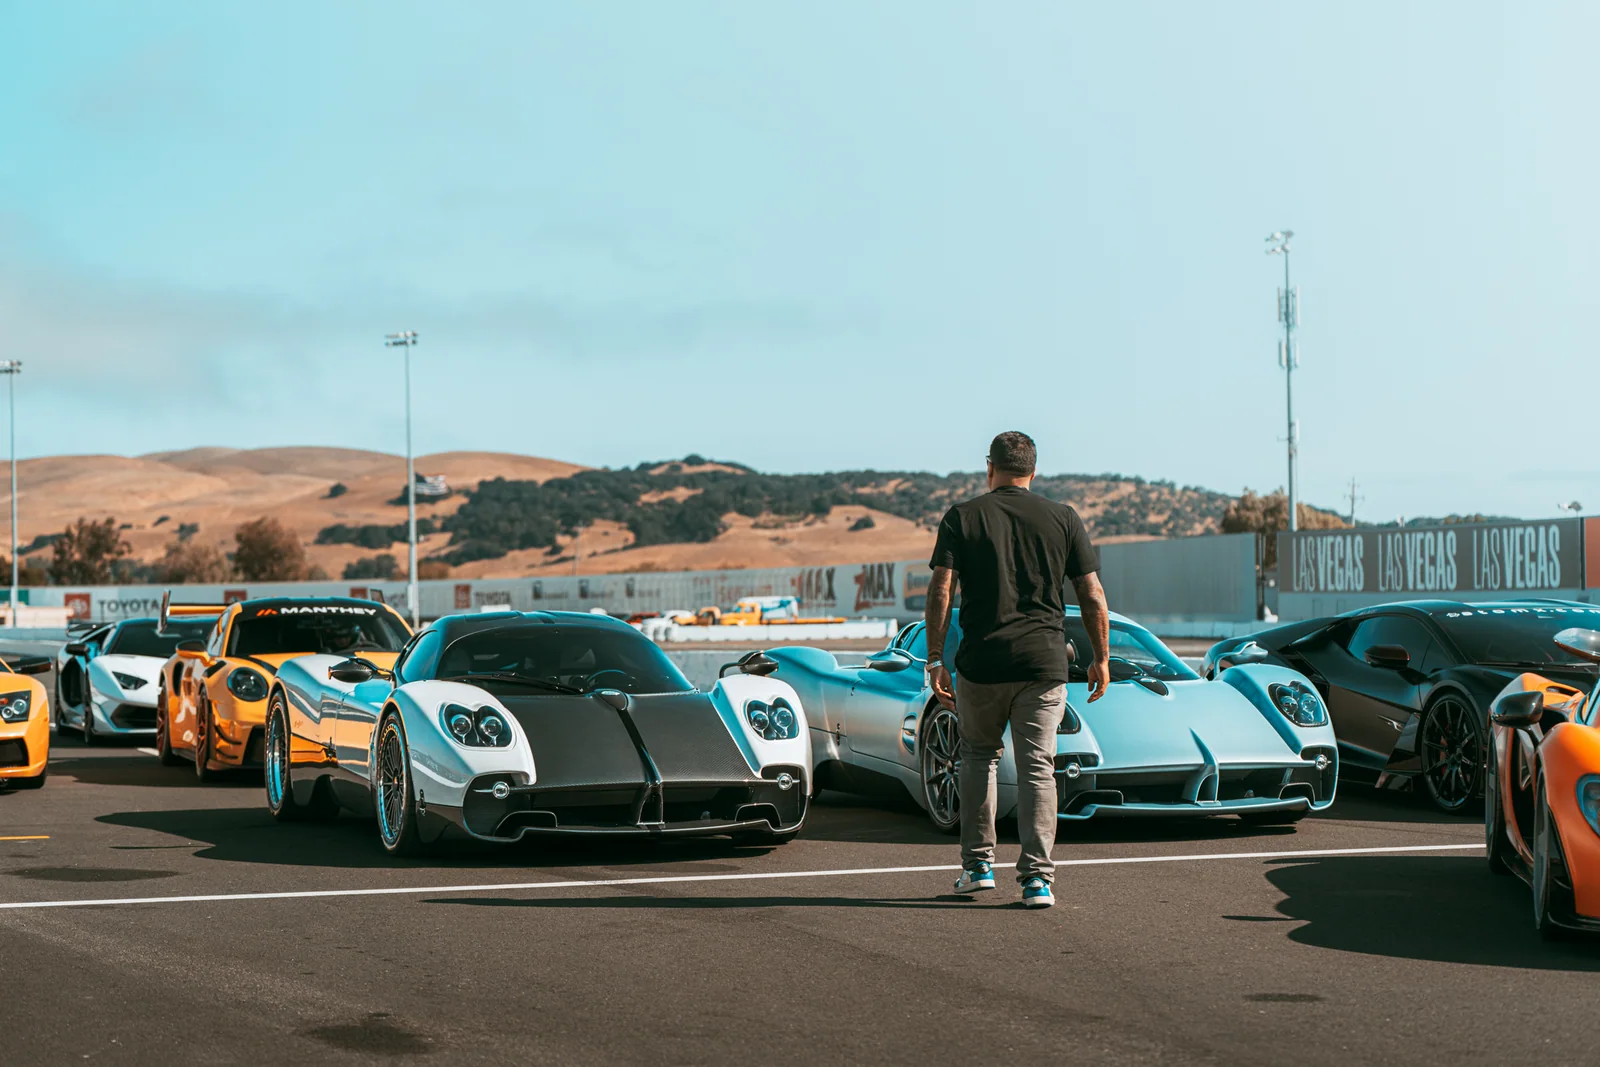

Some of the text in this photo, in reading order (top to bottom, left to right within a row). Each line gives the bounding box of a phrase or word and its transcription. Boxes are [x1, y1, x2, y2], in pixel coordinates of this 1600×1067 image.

[1292, 533, 1365, 592] LAS VEGAS
[1378, 529, 1458, 592] LAS VEGAS
[1473, 524, 1561, 590] LAS VEGAS
[98, 599, 161, 613] TOYOTA
[280, 606, 377, 616] MANTHEY
